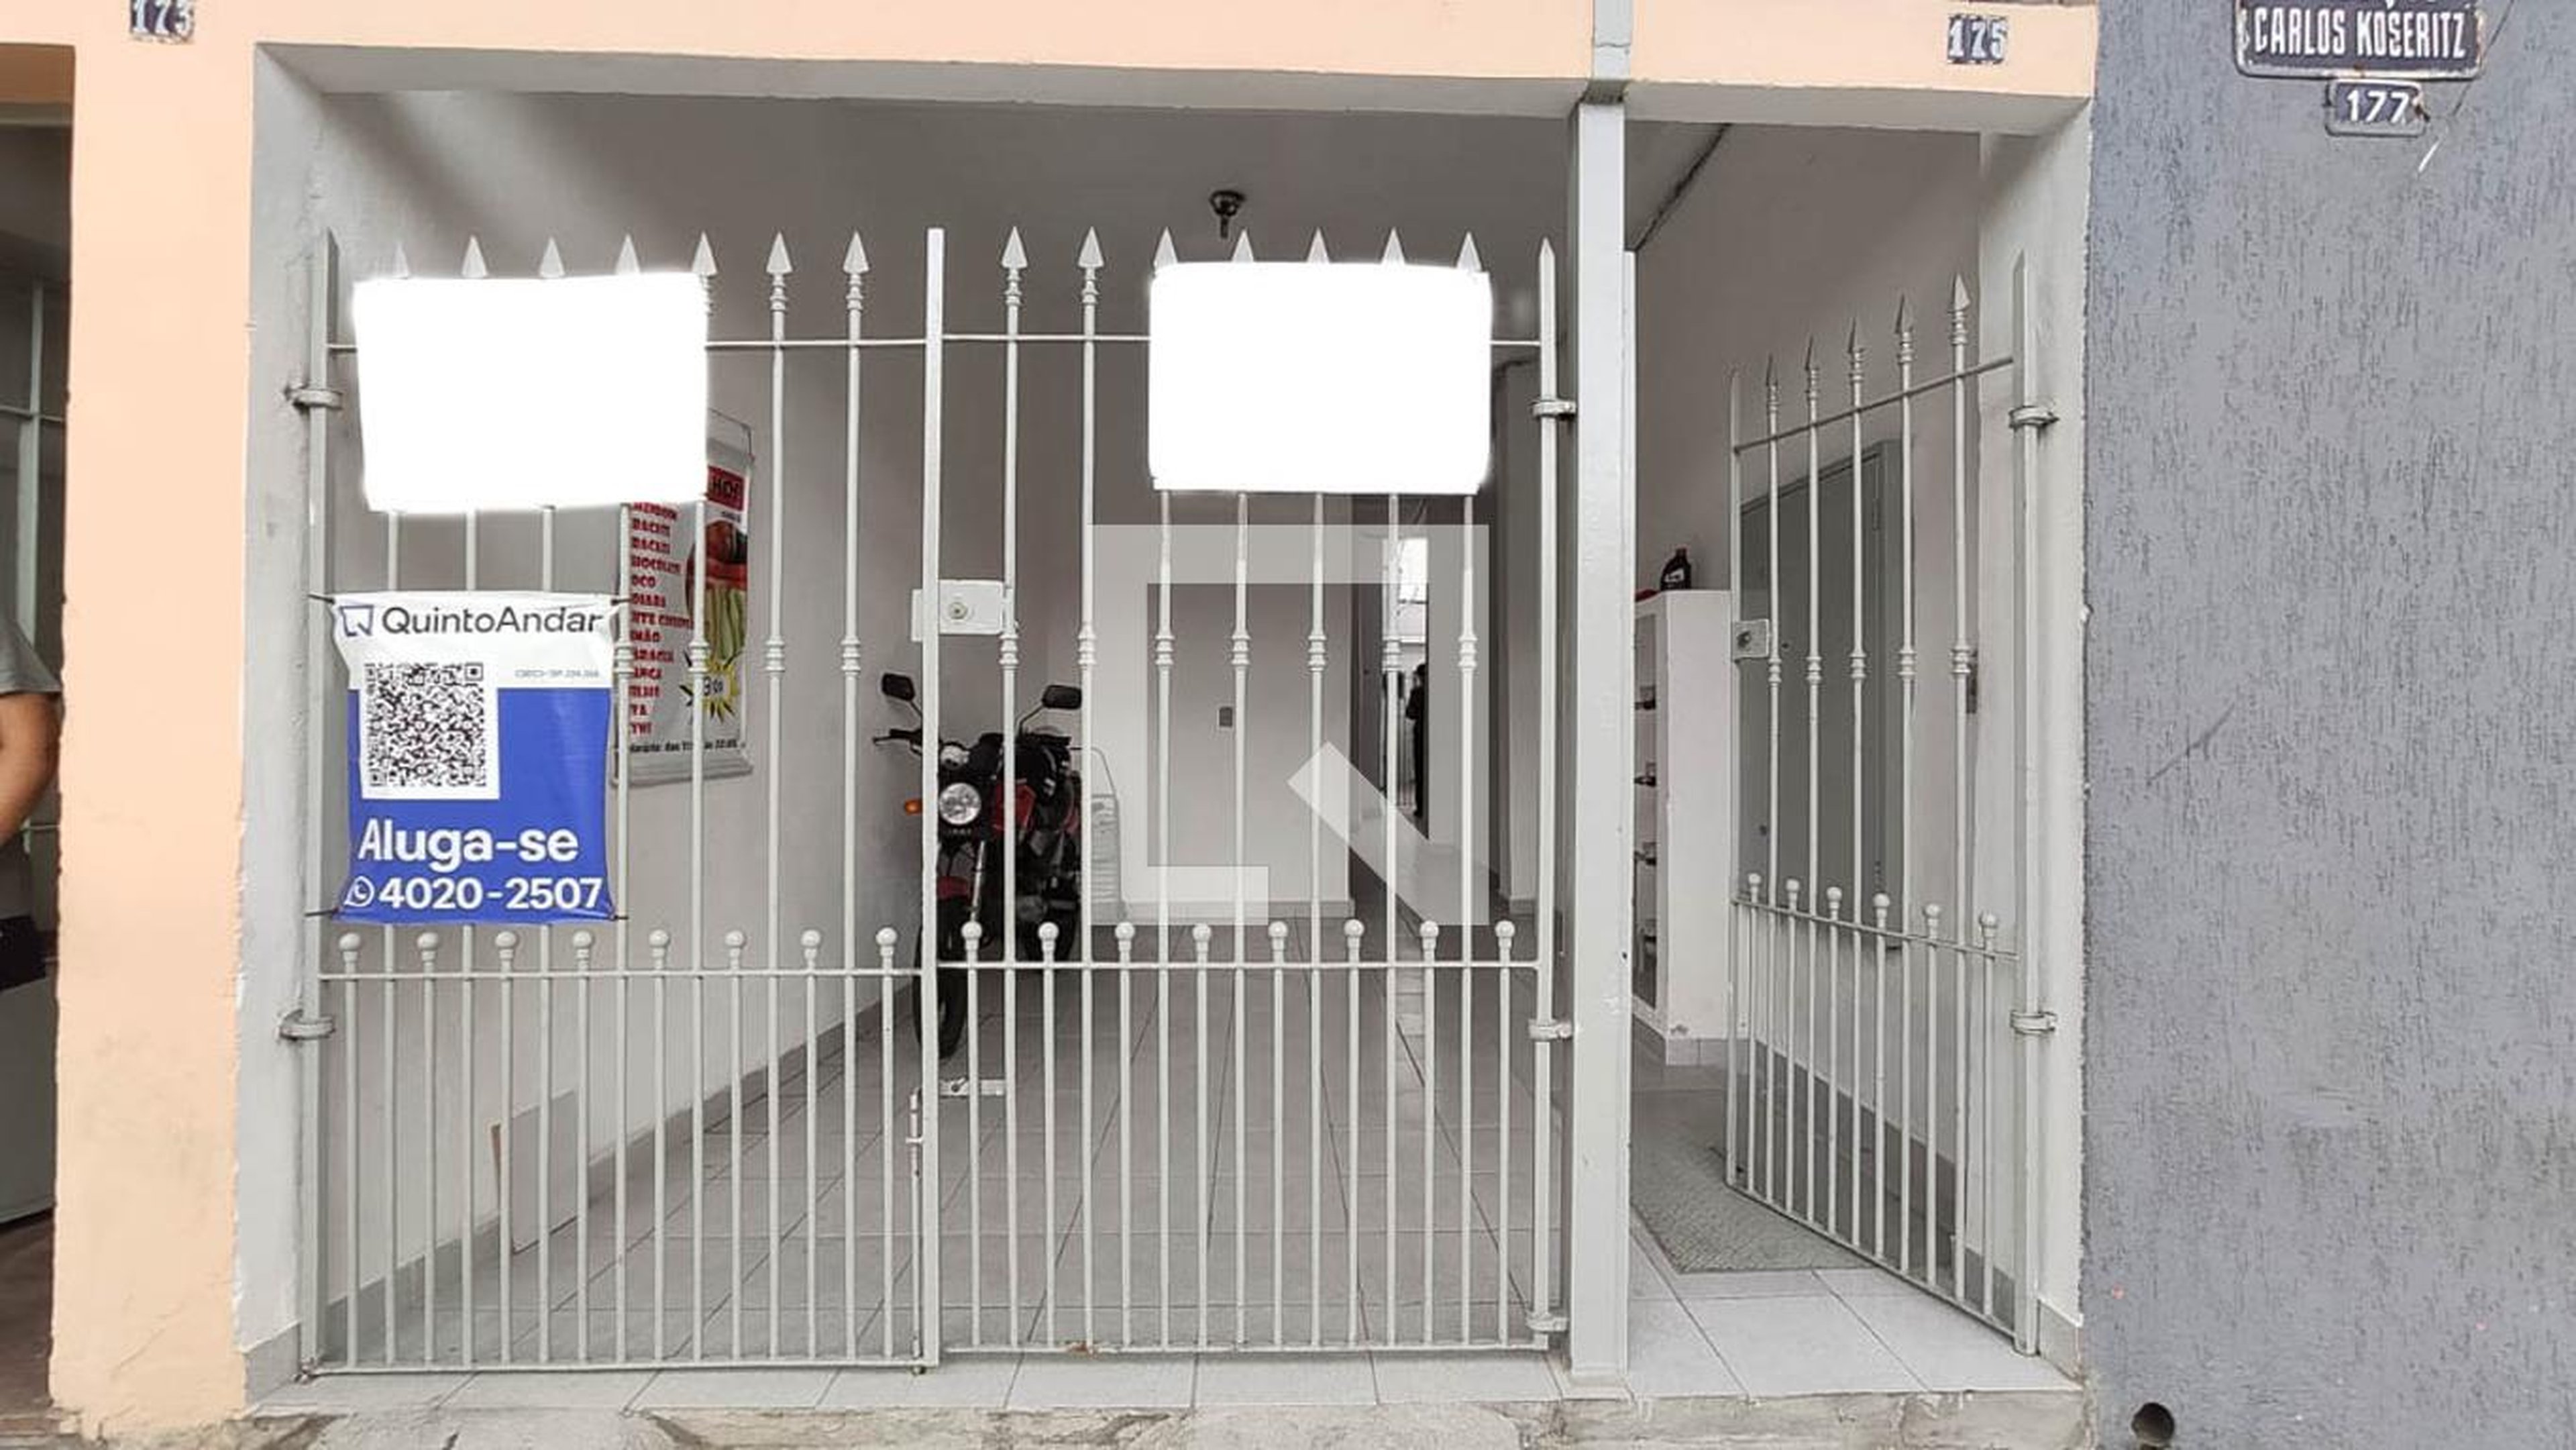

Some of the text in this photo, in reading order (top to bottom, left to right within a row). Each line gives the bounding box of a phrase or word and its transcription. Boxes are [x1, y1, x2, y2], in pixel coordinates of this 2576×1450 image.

[132, 0, 190, 36] 173
[2253, 7, 2466, 58] CARLOS KOSERITZ
[1948, 19, 2006, 58] 175
[2347, 89, 2410, 123] 177
[382, 606, 603, 635] QuintoAndar
[357, 818, 579, 872] Aluga-se
[378, 877, 602, 909] 4020-2507
